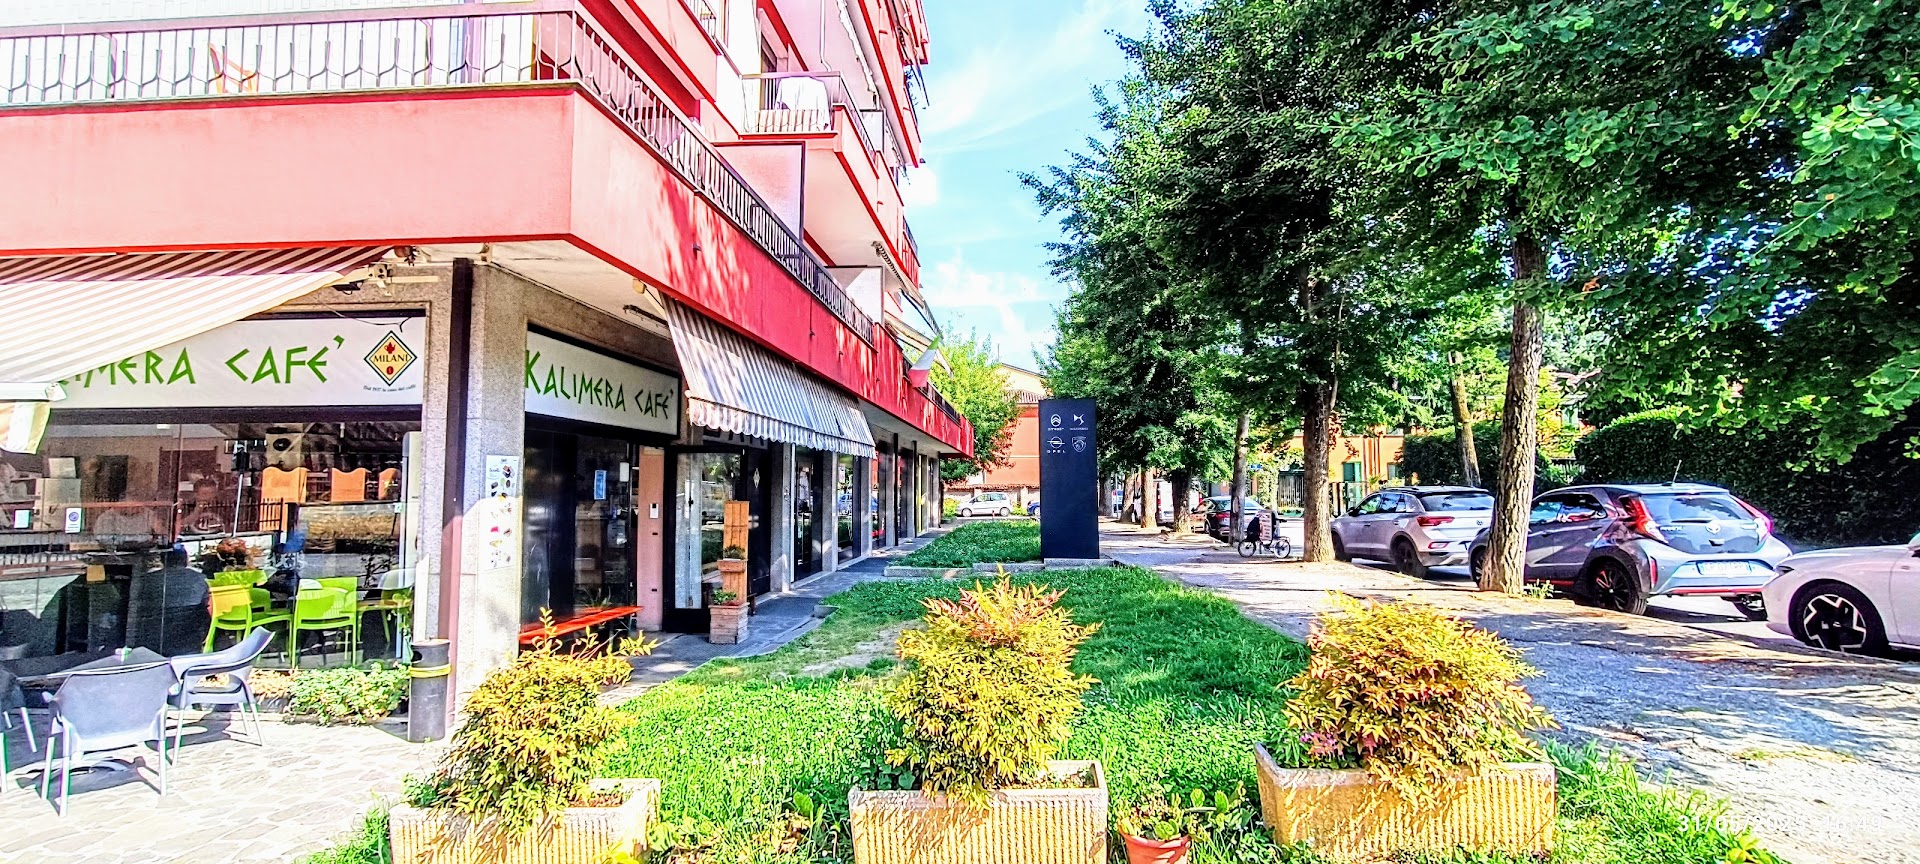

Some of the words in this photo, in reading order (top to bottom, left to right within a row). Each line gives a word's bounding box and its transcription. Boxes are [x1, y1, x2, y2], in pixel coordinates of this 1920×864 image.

[58, 347, 196, 388] MERA
[374, 354, 408, 362] MILANI
[525, 350, 626, 412] KALIMERA
